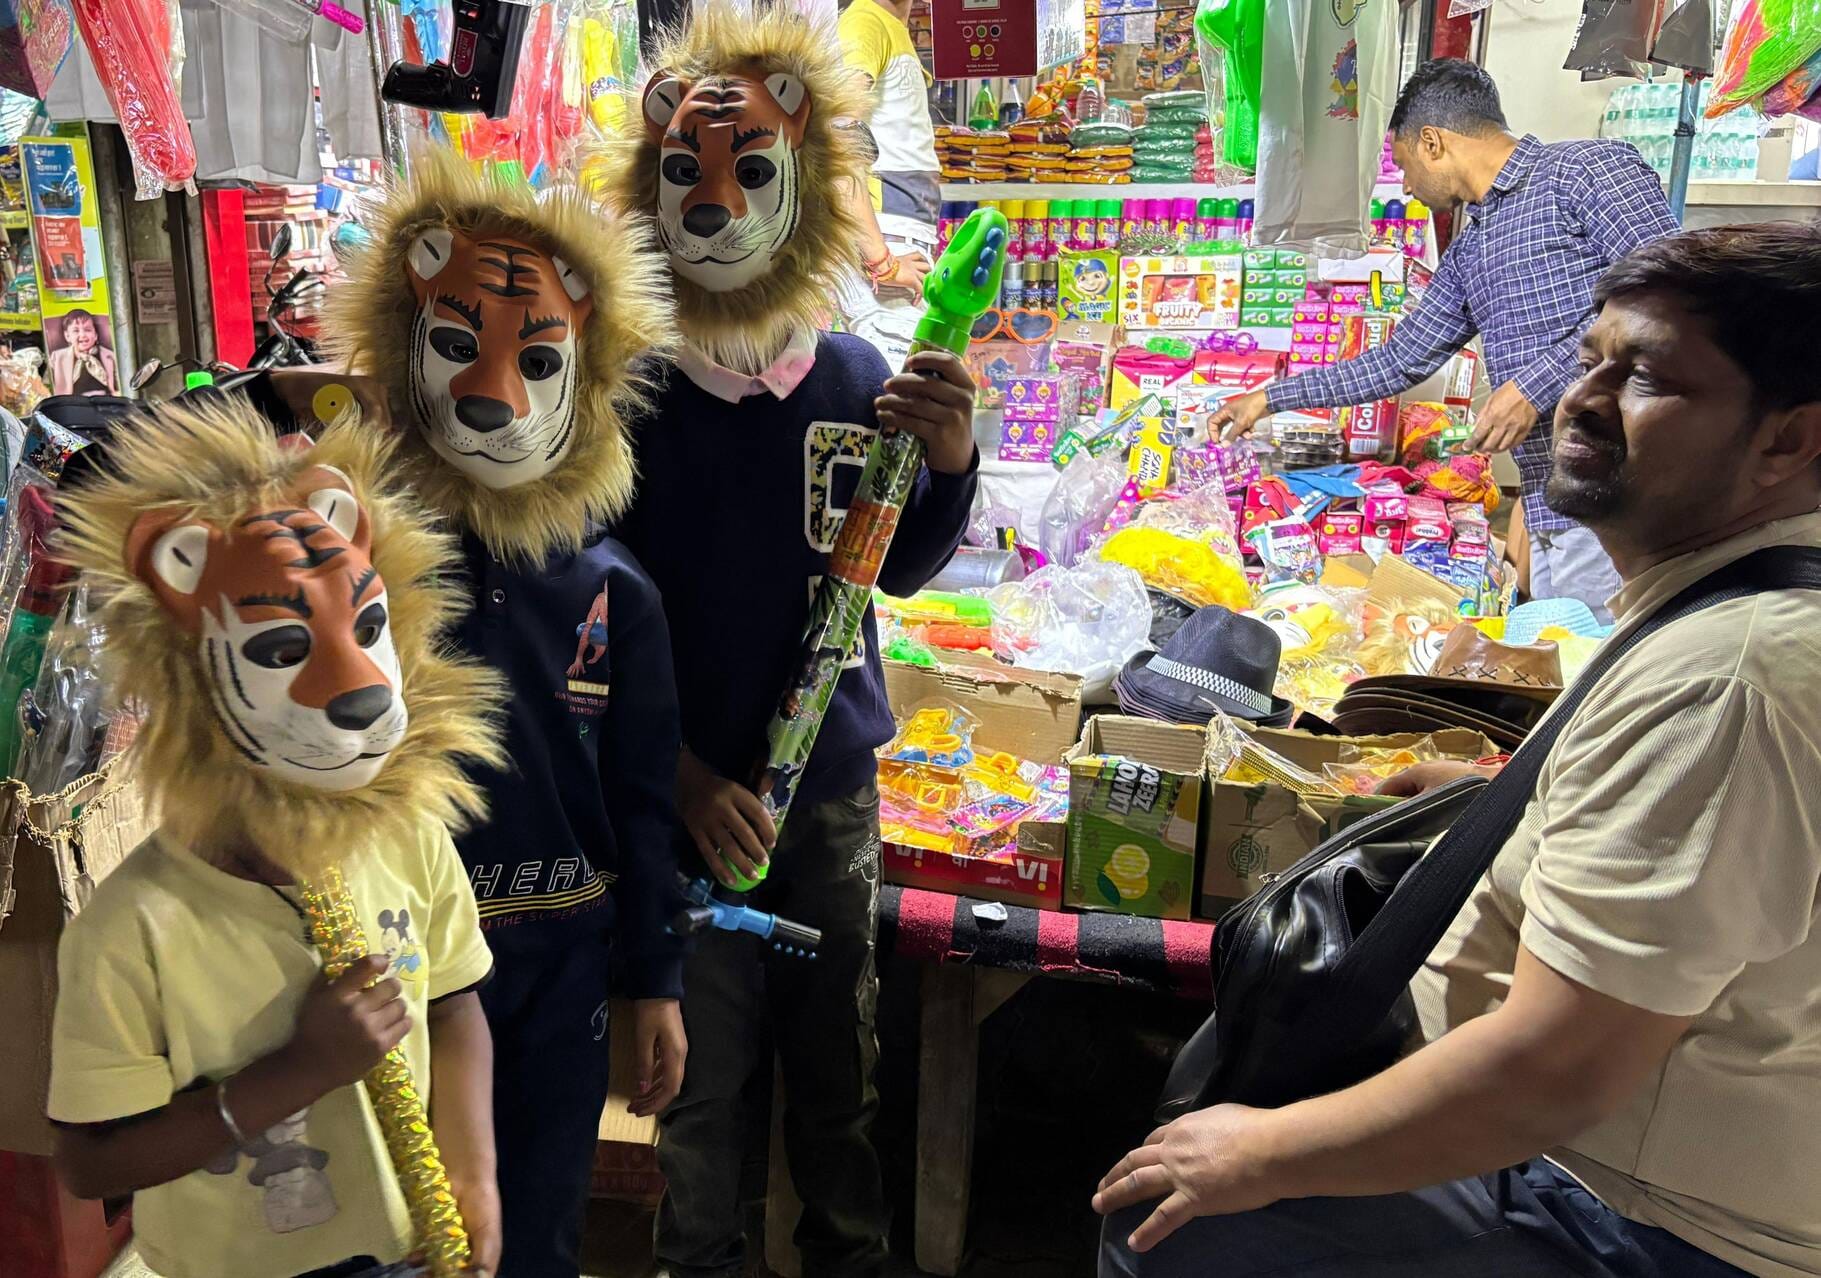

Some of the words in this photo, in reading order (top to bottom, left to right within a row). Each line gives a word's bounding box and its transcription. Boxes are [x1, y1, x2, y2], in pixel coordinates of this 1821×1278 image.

[1153, 302, 1203, 318] FRUITY
[1142, 378, 1161, 386] REAL
[1357, 402, 1374, 431] Col
[1107, 761, 1141, 816] LAHO
